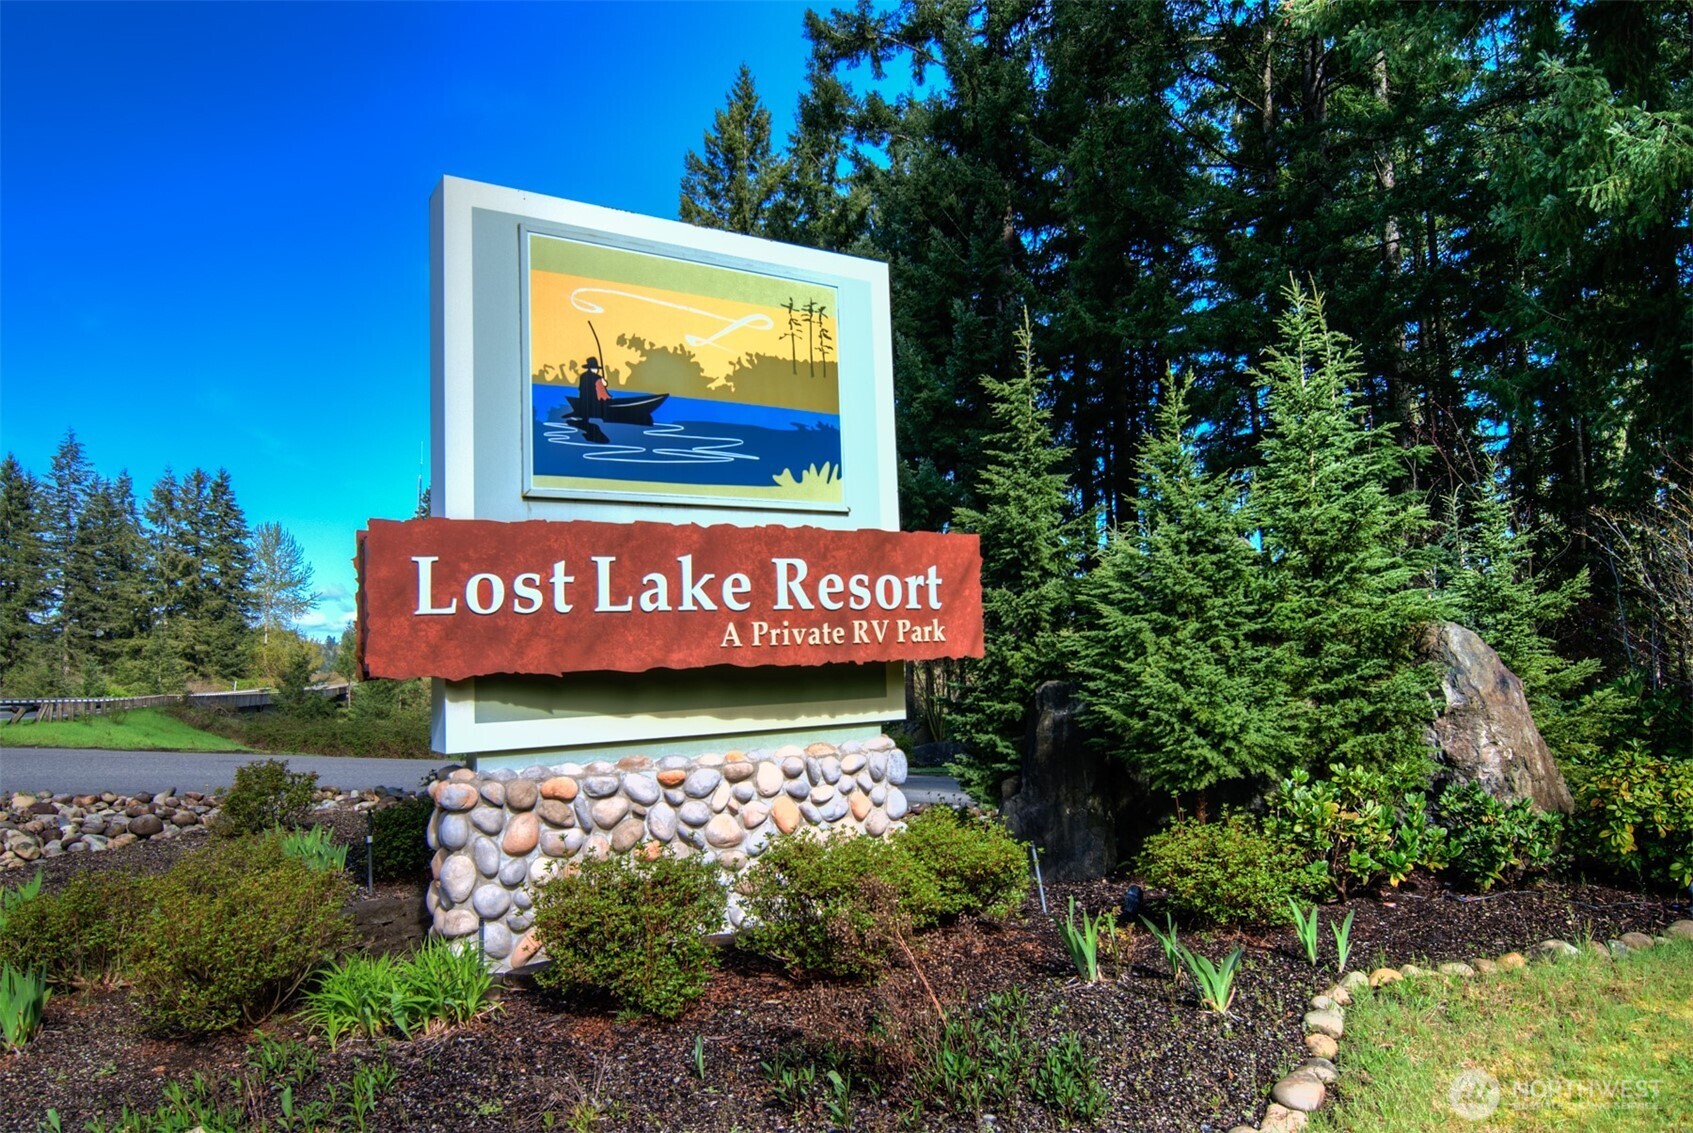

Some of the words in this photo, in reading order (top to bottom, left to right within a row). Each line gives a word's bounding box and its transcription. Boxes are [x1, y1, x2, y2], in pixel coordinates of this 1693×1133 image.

[410, 555, 577, 615] Lost
[590, 553, 752, 612] Lake
[770, 557, 943, 611] Resort
[719, 621, 744, 647] A
[750, 621, 846, 646] Private
[851, 619, 890, 644] RV
[895, 617, 947, 643] Park
